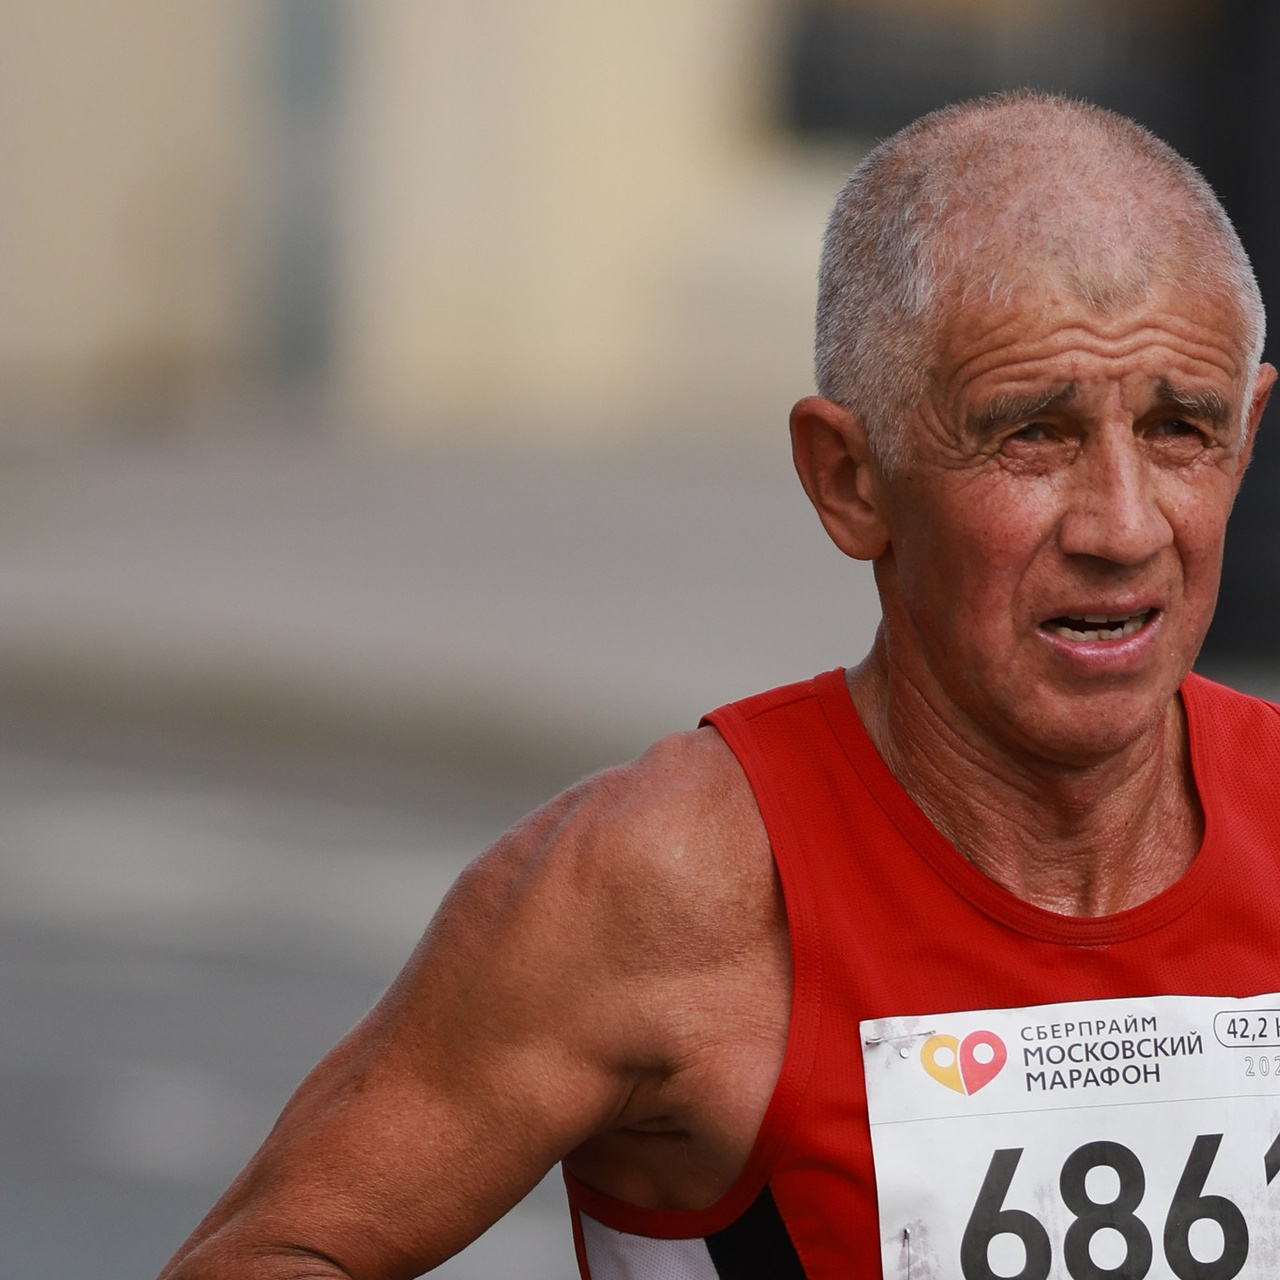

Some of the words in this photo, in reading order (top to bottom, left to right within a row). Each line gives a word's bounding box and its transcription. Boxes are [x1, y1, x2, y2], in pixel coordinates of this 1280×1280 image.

[1020, 1015, 1157, 1041] СБЕРПРАЙМ
[1227, 1017, 1268, 1042] 42,2
[1023, 1031, 1204, 1067] МОСКОВСКИЙ
[1026, 1063, 1161, 1092] МАРАФОН
